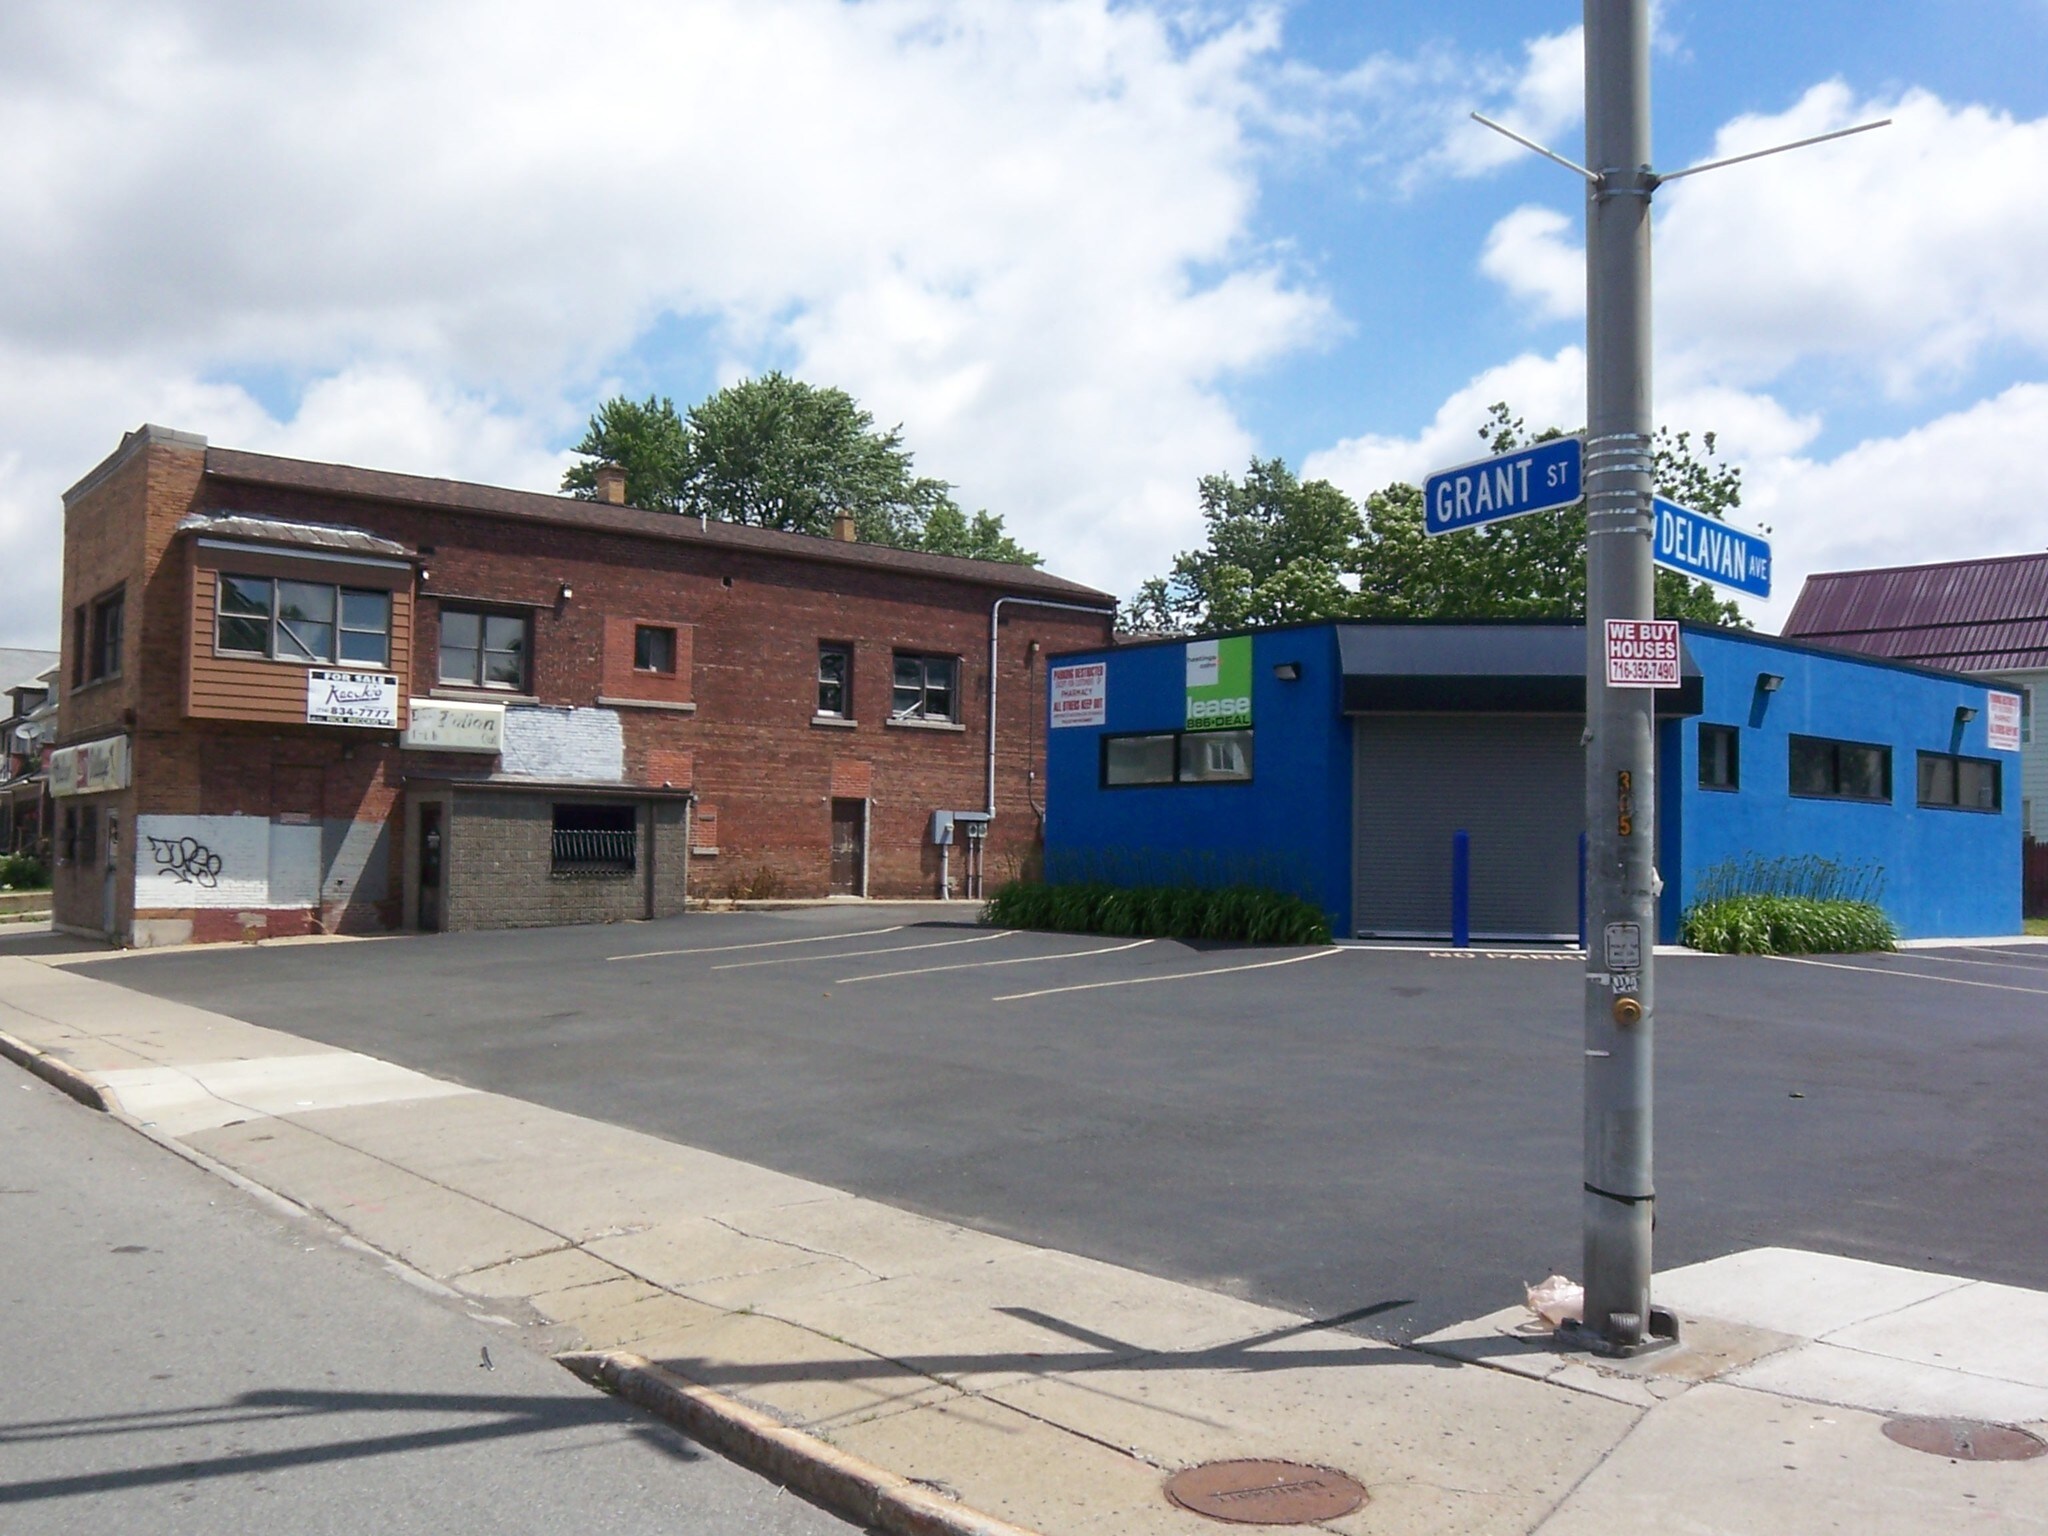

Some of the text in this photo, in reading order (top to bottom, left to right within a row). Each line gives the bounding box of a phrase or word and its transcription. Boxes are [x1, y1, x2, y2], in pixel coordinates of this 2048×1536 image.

[1437, 459, 1568, 523] GRANT ST
[1662, 511, 1746, 582] DELAVAN
[1749, 557, 1767, 580] AVE
[1609, 623, 1675, 641] WE BUY
[1610, 640, 1676, 659] HOUSES
[324, 672, 385, 685] FOR SALE
[1613, 661, 1674, 679] 716-352-7490
[1061, 688, 1093, 698] PHARMACY
[331, 707, 390, 718] 834-7777
[1187, 696, 1250, 719] lease
